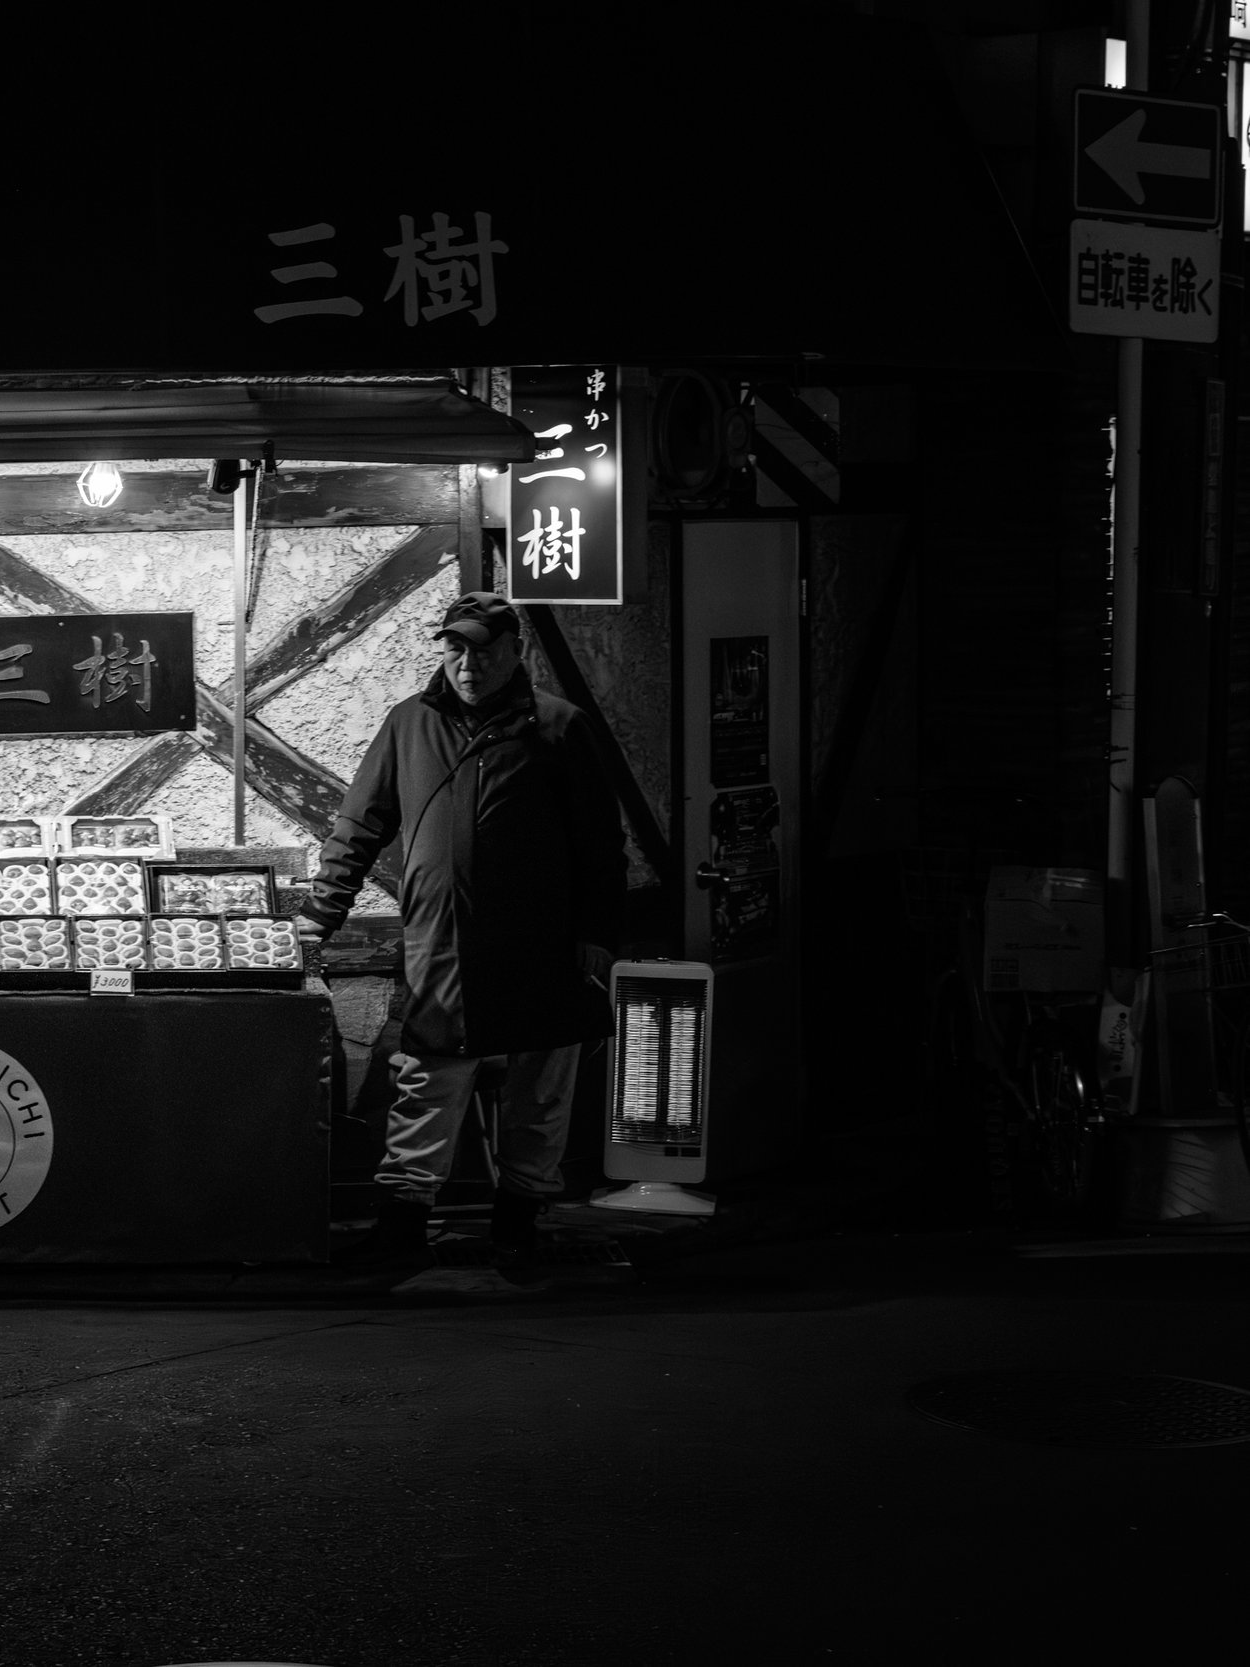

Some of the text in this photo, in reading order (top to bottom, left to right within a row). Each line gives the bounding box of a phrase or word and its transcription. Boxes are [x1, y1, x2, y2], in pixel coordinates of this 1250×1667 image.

[253, 210, 510, 327] 三樹
[1078, 247, 1213, 316] 自転車を除く
[584, 368, 610, 458] 串かつ
[517, 423, 586, 580] 三樹
